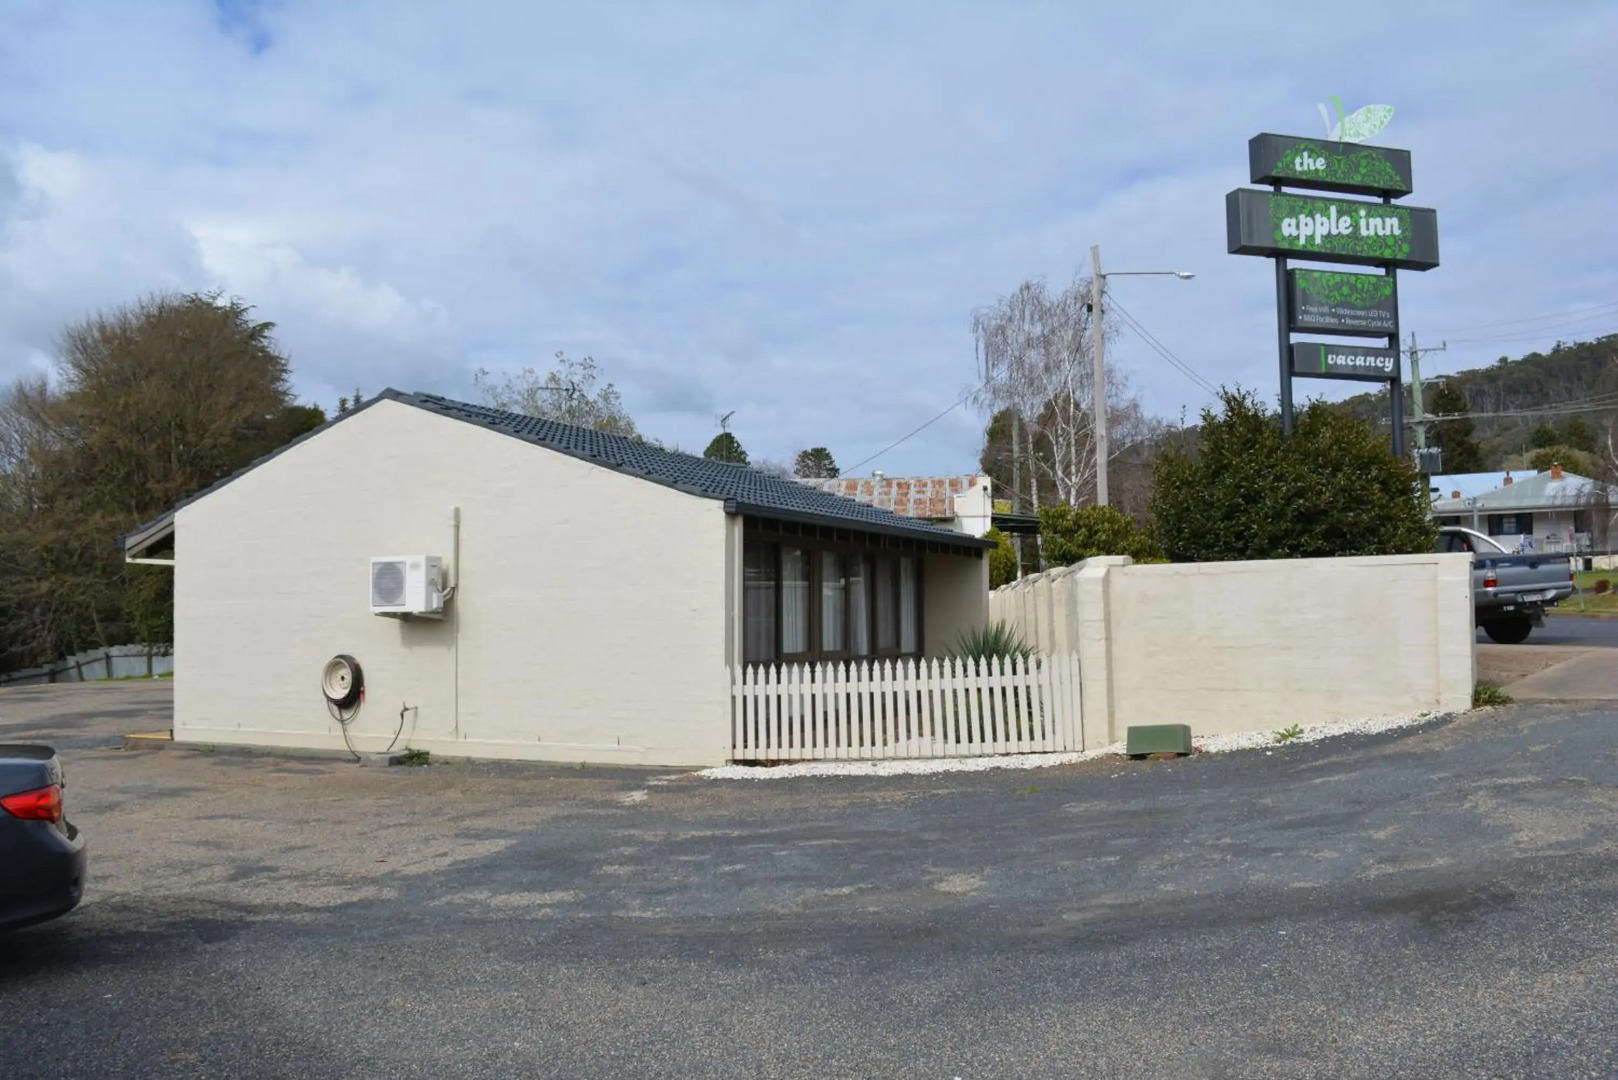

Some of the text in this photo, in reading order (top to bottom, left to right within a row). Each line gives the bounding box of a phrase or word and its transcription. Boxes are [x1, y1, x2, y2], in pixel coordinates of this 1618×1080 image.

[1294, 151, 1327, 172] the
[1281, 205, 1402, 245] apple inn
[1346, 318, 1367, 326] Reverse
[1368, 319, 1382, 328] Cycle
[1382, 320, 1394, 328] A/C
[1327, 353, 1394, 372] vacancy
